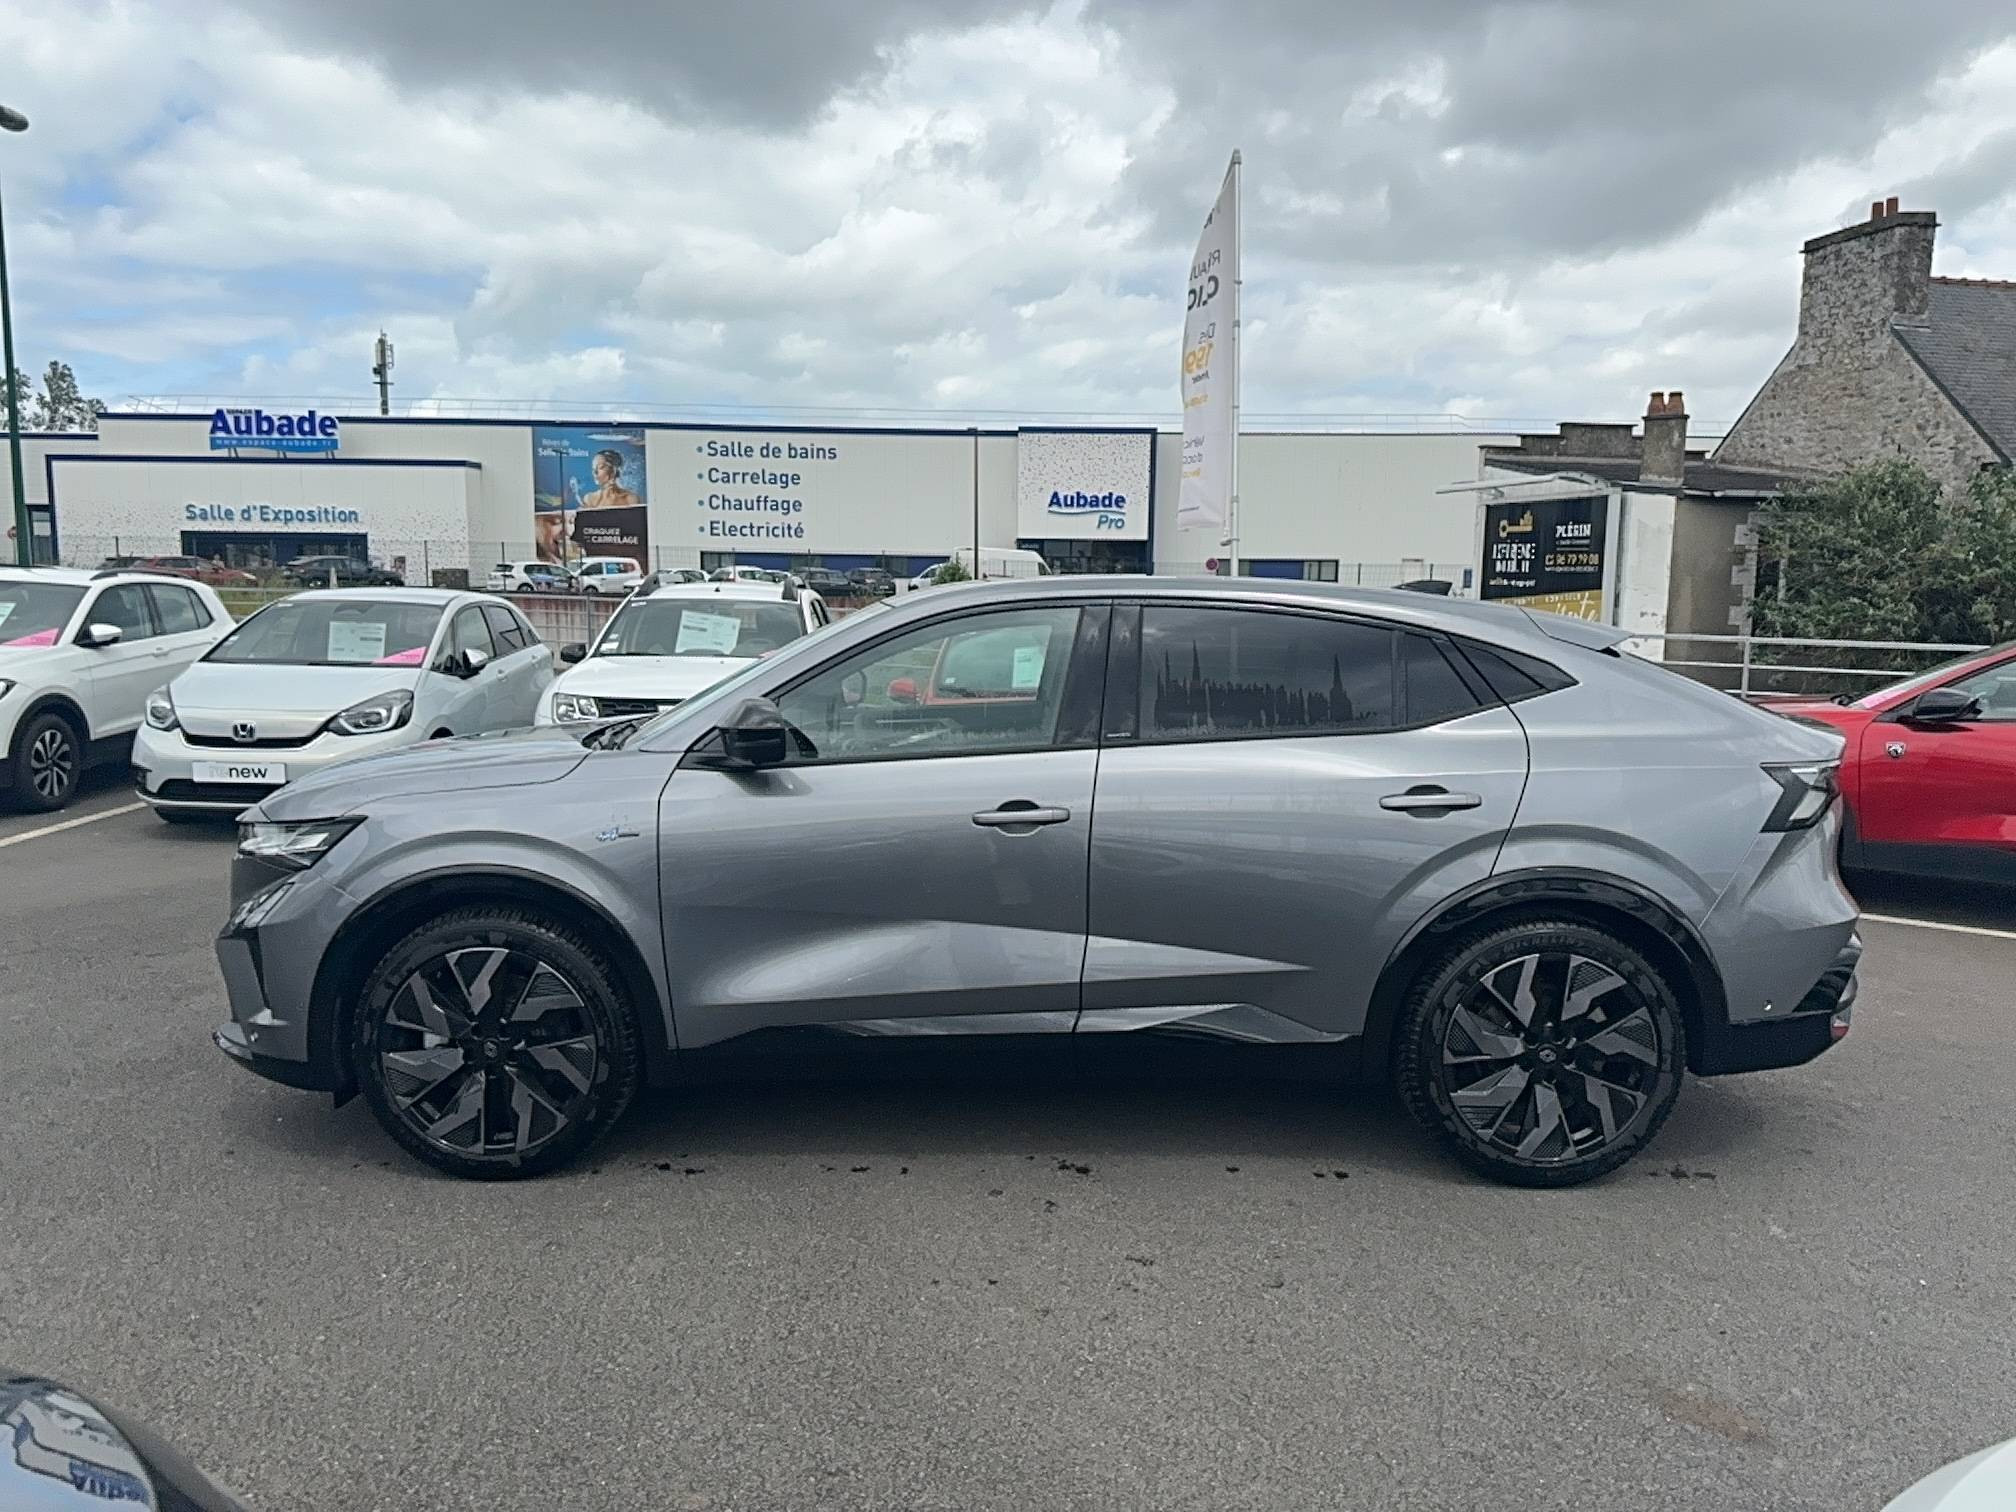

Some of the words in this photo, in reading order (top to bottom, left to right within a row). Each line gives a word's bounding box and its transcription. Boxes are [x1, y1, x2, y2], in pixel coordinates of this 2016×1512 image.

[209, 408, 338, 436] Aubade
[707, 440, 754, 458] Salle
[760, 442, 782, 459] de
[788, 443, 838, 460] bains
[708, 467, 802, 489] Carrelage
[709, 494, 803, 516] Chauffage
[1048, 491, 1126, 508] Aubade
[185, 504, 235, 521] Salle
[241, 505, 360, 524] d'Exposition
[1097, 514, 1126, 529] Pro
[710, 520, 805, 539] Electricité
[592, 535, 639, 545] CARRELAGE
